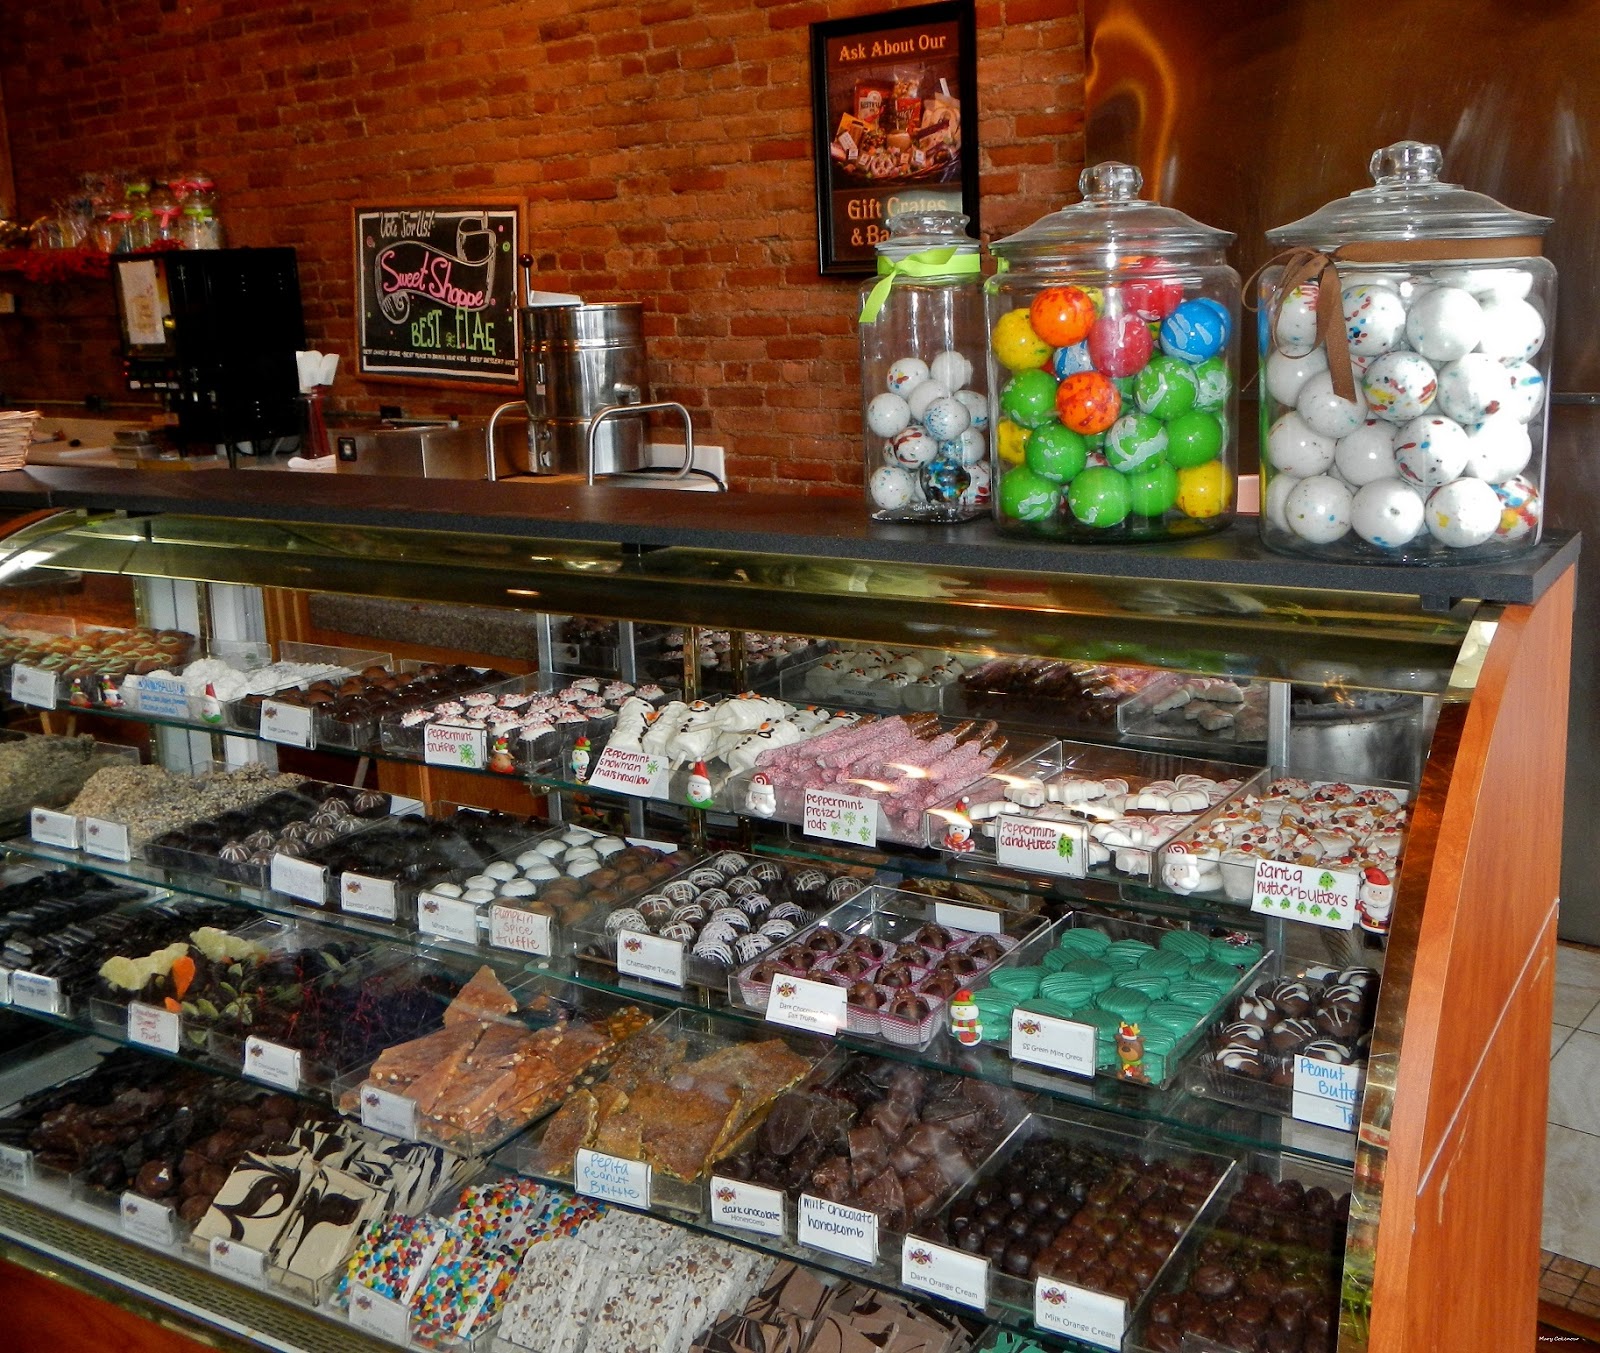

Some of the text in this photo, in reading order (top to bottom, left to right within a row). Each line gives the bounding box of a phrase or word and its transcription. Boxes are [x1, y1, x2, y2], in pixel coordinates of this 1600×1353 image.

[839, 34, 946, 61] Ask About Our
[847, 198, 883, 219] Gift
[851, 228, 864, 246] &
[381, 250, 484, 307] Sweet Shoppe
[411, 309, 443, 348] BEST
[455, 306, 497, 356] FLAG
[807, 818, 828, 831] rods
[1031, 1044, 1049, 1055] Green
[1049, 1047, 1064, 1058] Mint
[1065, 1051, 1083, 1062] Oreos
[1300, 1057, 1346, 1081] Peanut
[730, 1214, 766, 1227] Honeycomb
[743, 1207, 780, 1222] chocolate
[910, 1271, 978, 1300] Dark Orange Cream
[1044, 1311, 1117, 1340] Milk Orange Cream
